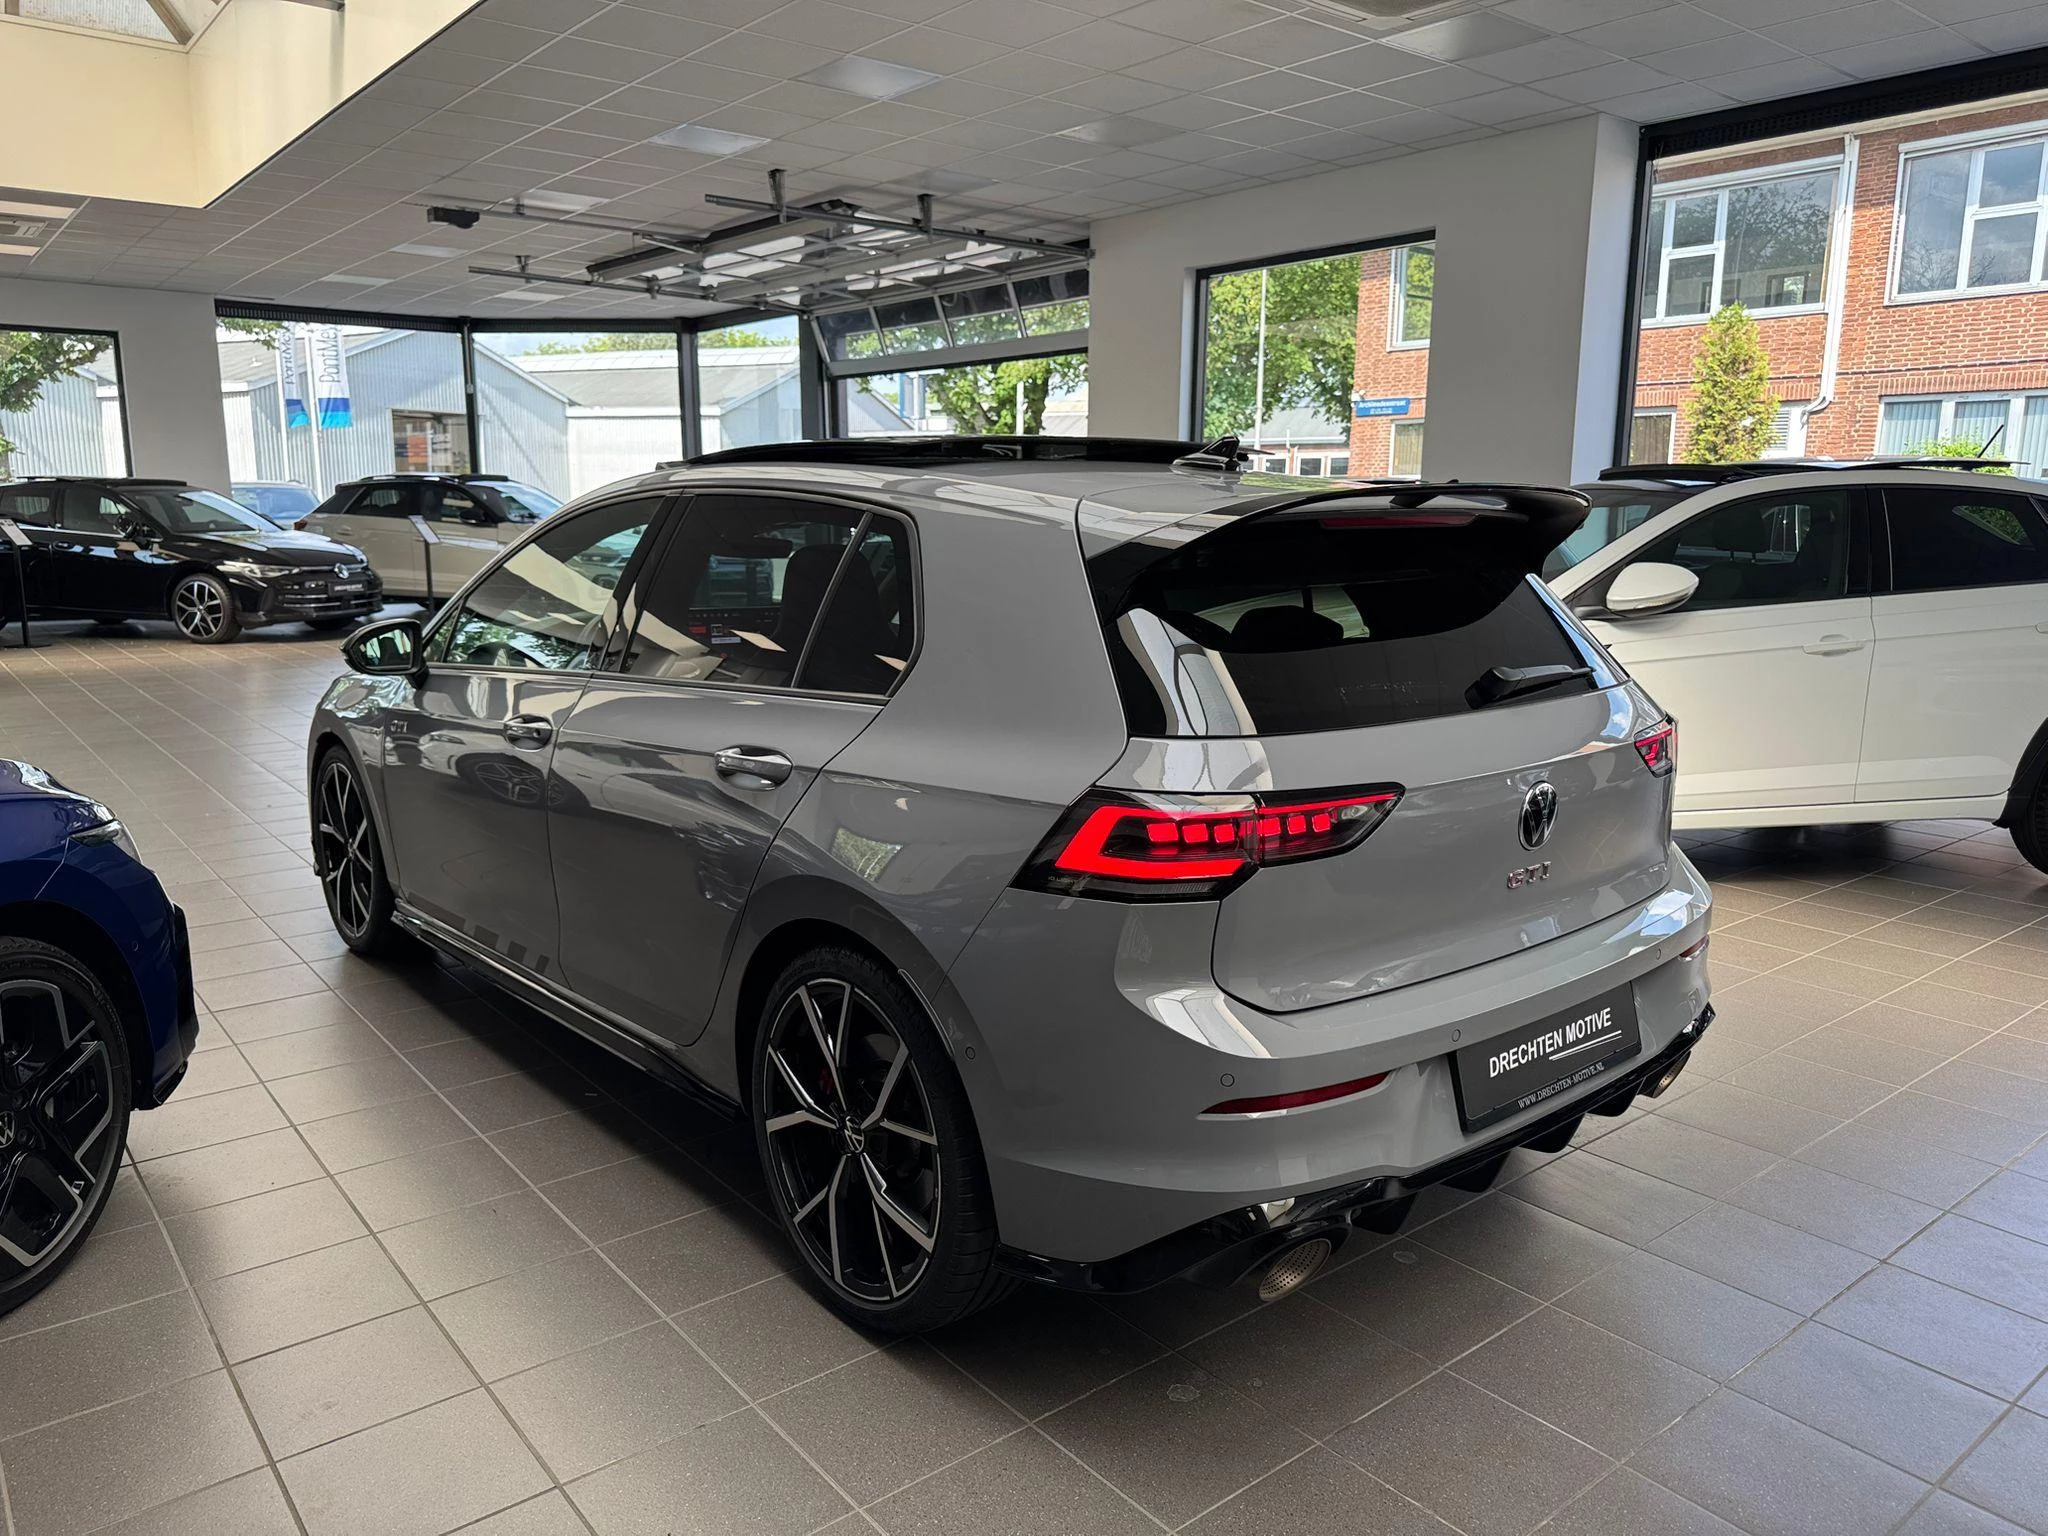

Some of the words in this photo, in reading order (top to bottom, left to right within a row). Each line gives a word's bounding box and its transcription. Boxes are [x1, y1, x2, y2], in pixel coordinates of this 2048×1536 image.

[1507, 861, 1551, 888] GTI
[1489, 1028, 1563, 1078] DRECHTEN
[1565, 1007, 1612, 1044] MOTIVE
[1517, 1061, 1605, 1109] WWW.DRECHTEN-MOTIVE.NL
